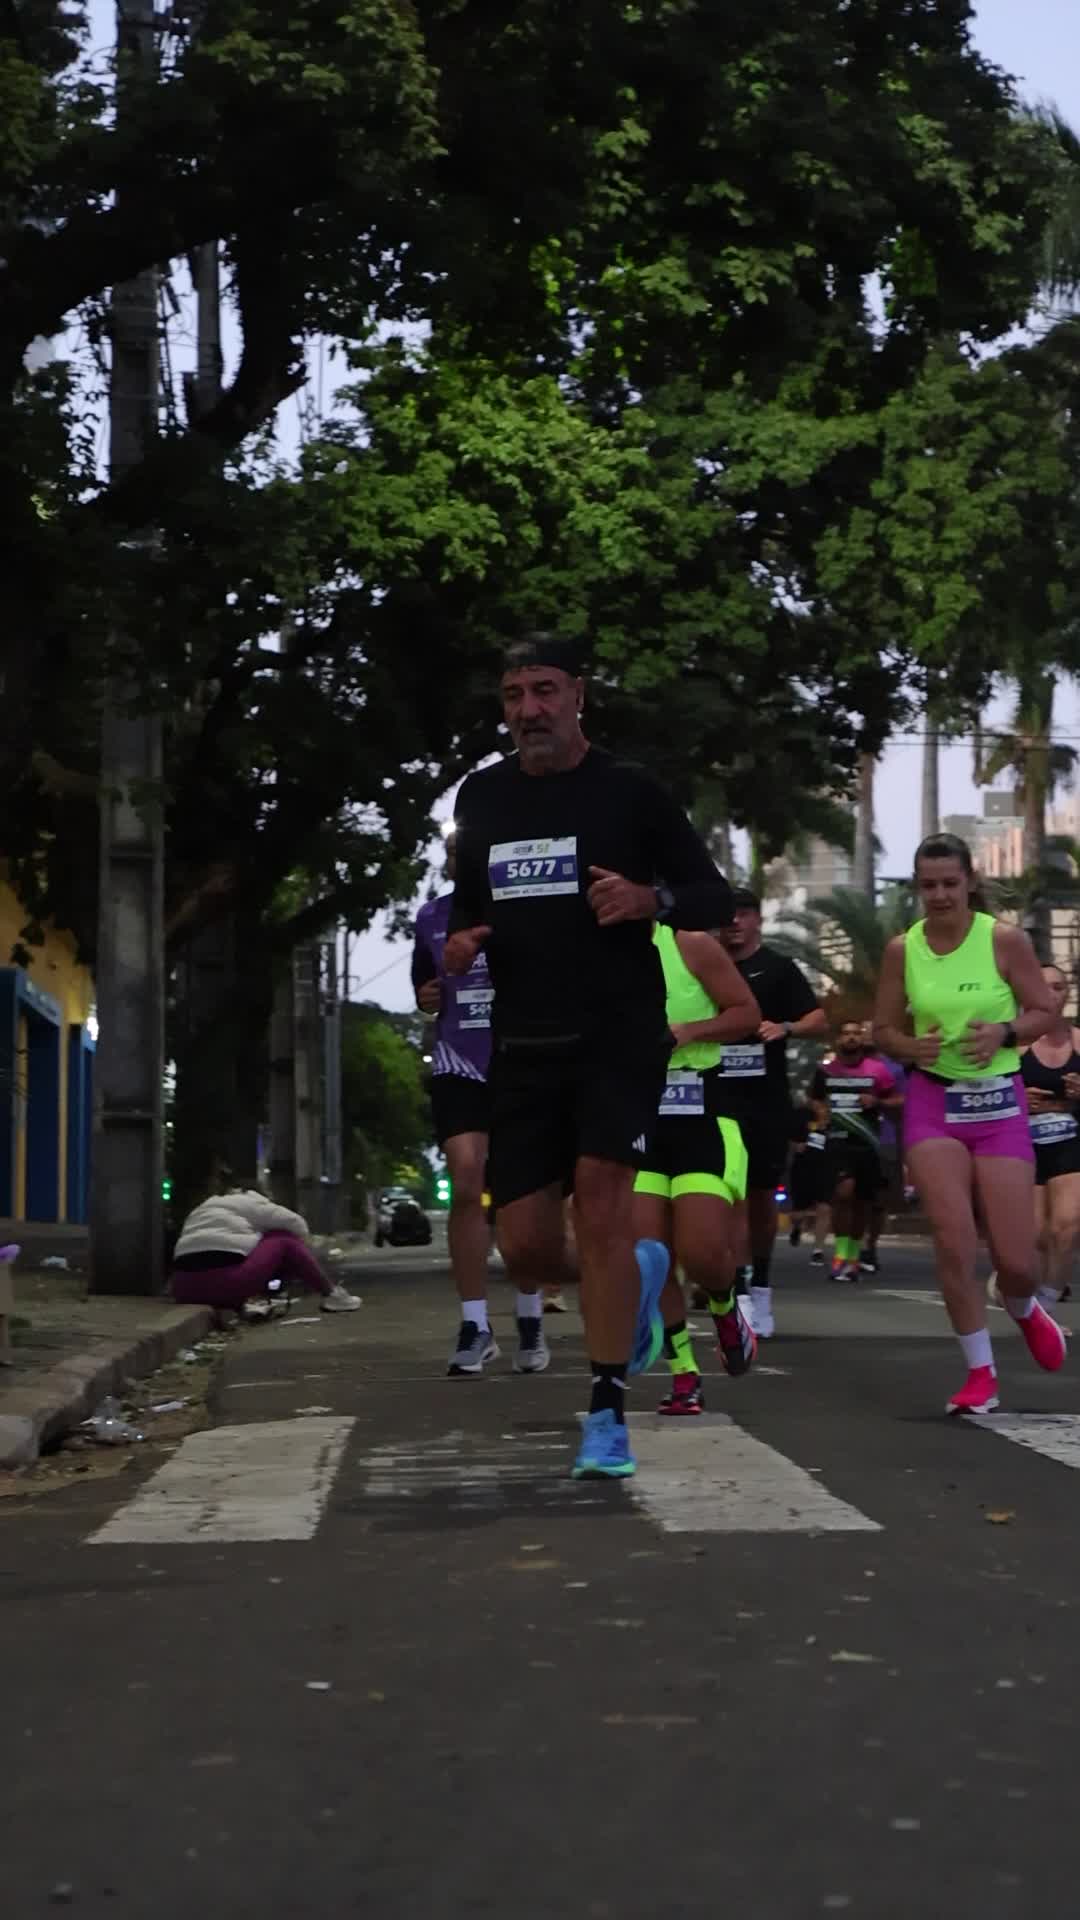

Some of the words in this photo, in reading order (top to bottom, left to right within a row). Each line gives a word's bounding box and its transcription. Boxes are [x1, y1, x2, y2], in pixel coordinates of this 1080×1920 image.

[507, 860, 556, 879] 5677
[661, 1086, 686, 1099] 61
[960, 1091, 1004, 1108] 5040
